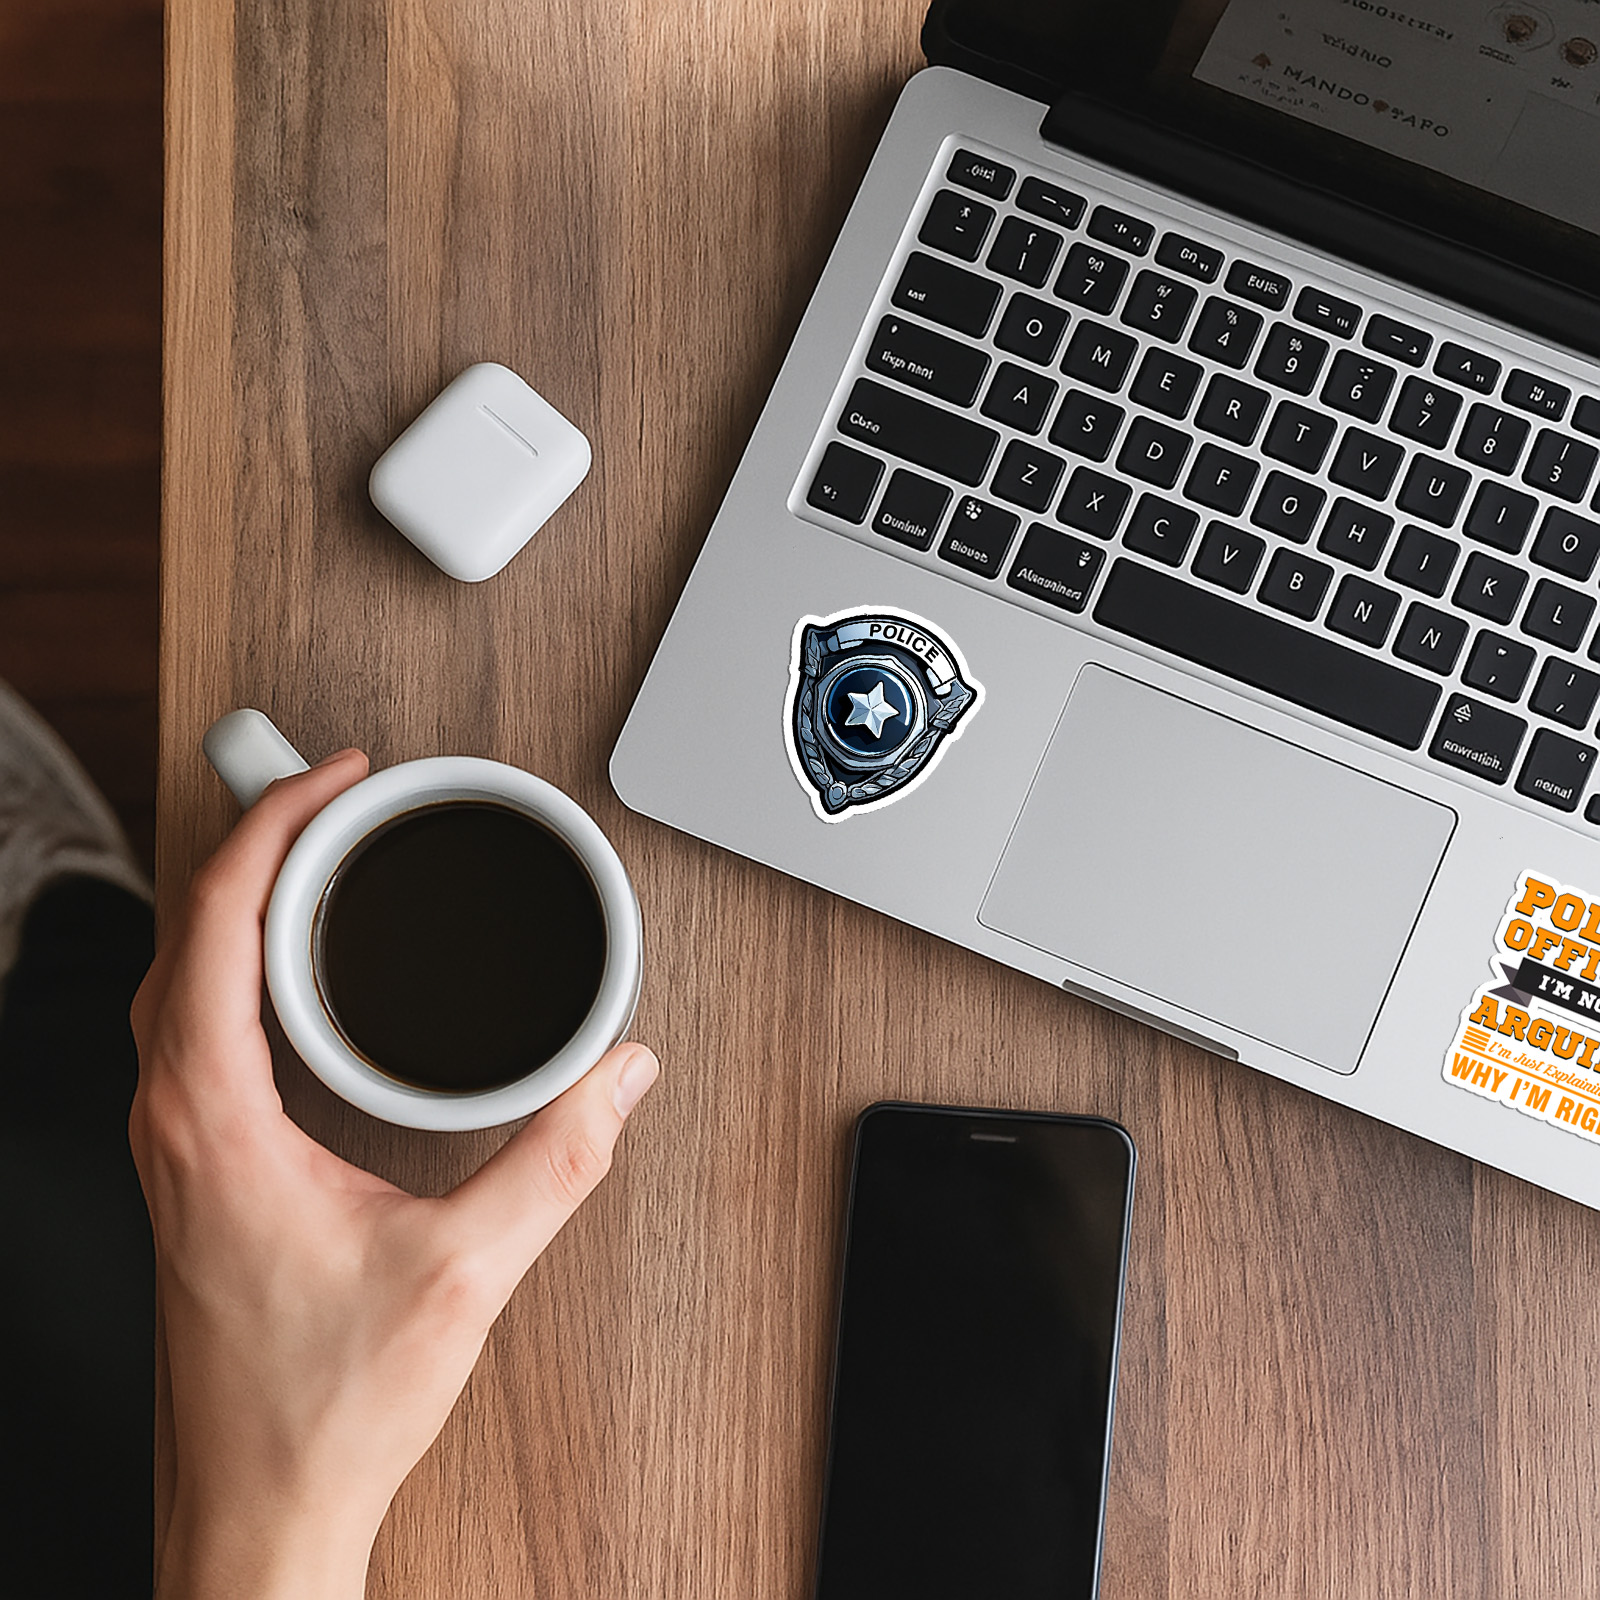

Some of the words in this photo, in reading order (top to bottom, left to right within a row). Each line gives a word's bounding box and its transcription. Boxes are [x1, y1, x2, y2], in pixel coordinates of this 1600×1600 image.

[1082, 278, 1096, 295] 7
[1025, 318, 1043, 337] O
[1091, 345, 1112, 368] M
[1284, 357, 1298, 373] 9
[1159, 372, 1176, 391] E
[1012, 386, 1028, 405] A
[1350, 384, 1364, 400] 6
[1226, 399, 1242, 420] R
[1418, 410, 1431, 427] 7
[1082, 414, 1096, 433] S
[1296, 423, 1311, 442] T
[1146, 441, 1164, 460] D
[1483, 437, 1497, 454] 8
[1362, 452, 1378, 471] V
[1020, 463, 1039, 485] Z
[1216, 468, 1231, 485] F
[1549, 465, 1562, 483] 3
[1428, 477, 1446, 497] U
[1085, 491, 1105, 512] X
[1153, 518, 1170, 538] C
[1347, 524, 1367, 543] H
[1223, 544, 1239, 565] V
[1289, 571, 1304, 590] B
[1481, 577, 1498, 597] K
[1353, 600, 1373, 623] N
[1552, 605, 1562, 625] L
[869, 623, 940, 664] POLICE
[1420, 627, 1442, 650] N
[1538, 974, 1574, 1001] I'M
[1488, 1041, 1511, 1060] I'm
[1513, 1052, 1545, 1072] Just
[1451, 1052, 1508, 1093] WHY
[1509, 1077, 1553, 1112] I'M
[1555, 1096, 1600, 1136] RIG
